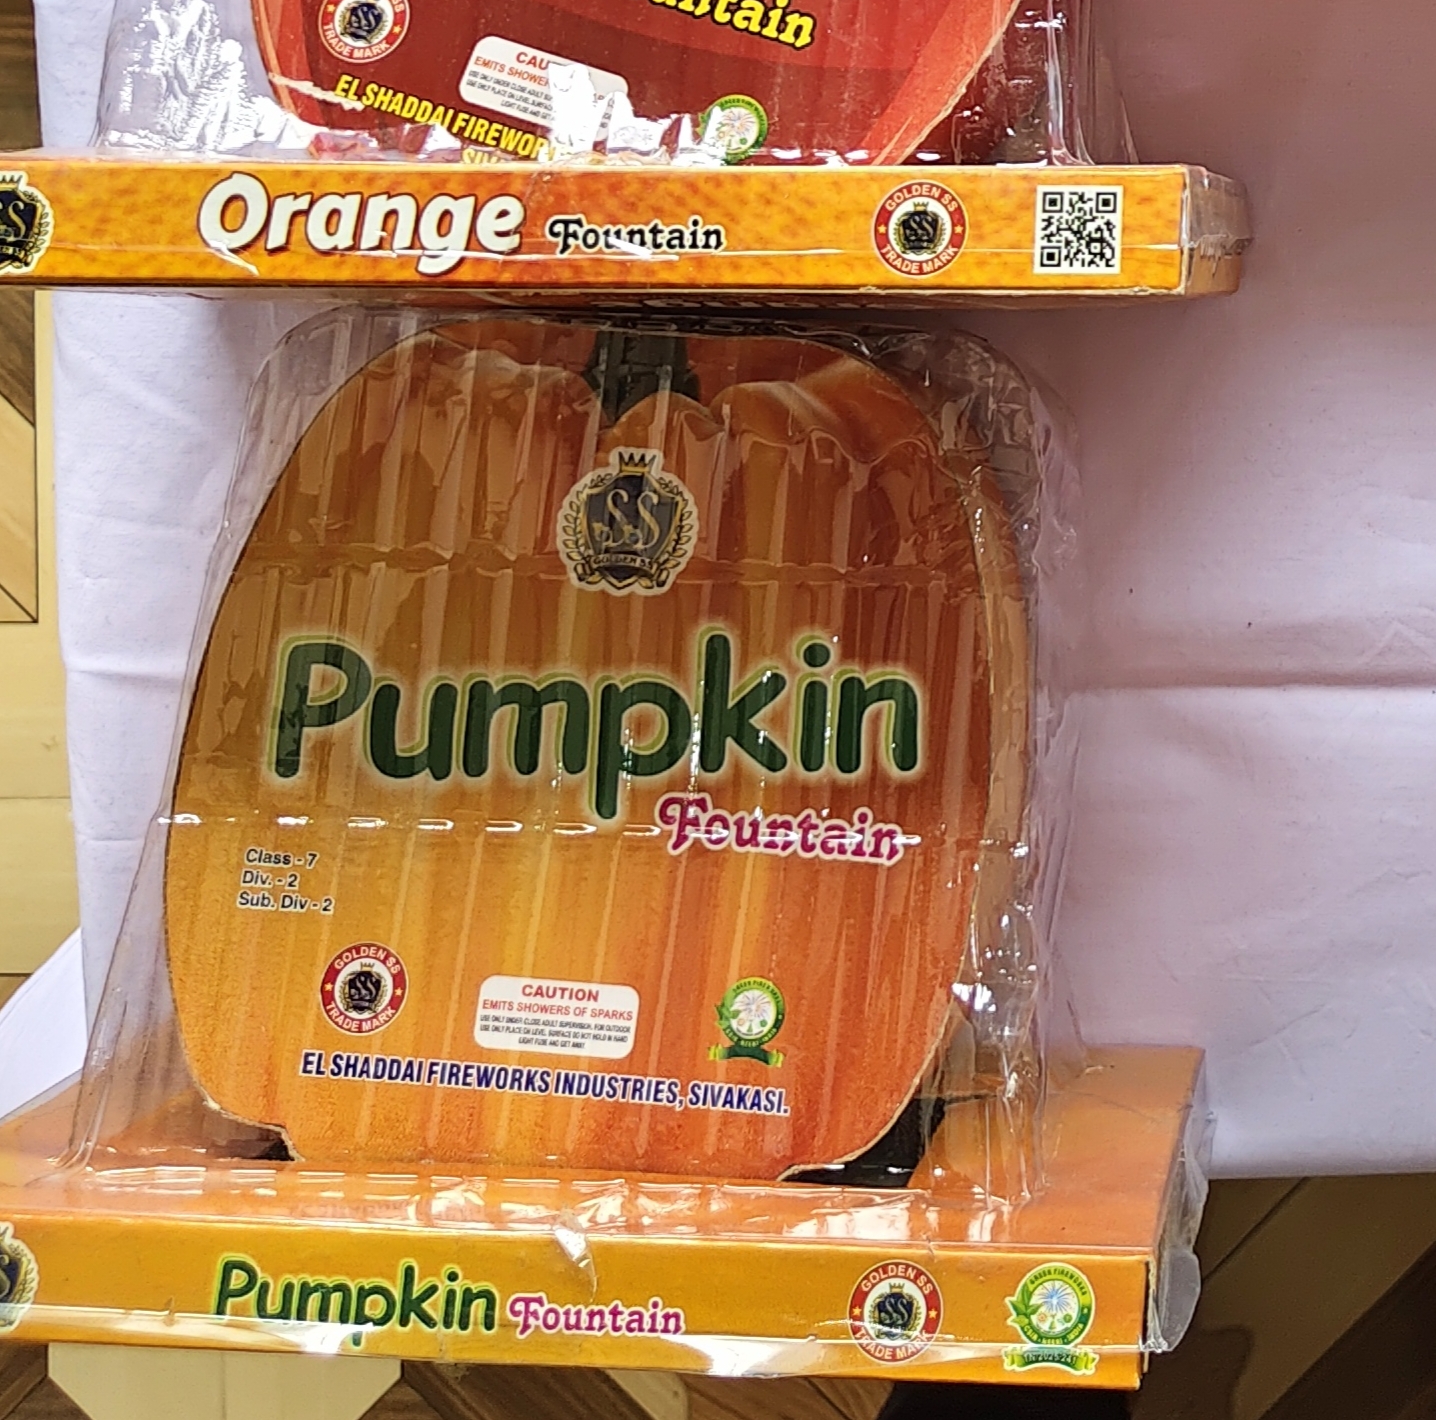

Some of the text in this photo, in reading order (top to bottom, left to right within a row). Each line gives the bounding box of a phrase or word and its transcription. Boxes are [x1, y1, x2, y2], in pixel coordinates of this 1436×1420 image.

[323, 23, 390, 58] TRADE MARK
[335, 75, 359, 101] EL
[362, 83, 454, 127] SHADDAI
[884, 184, 941, 211] GOLDEN
[199, 173, 724, 276] Orange Fountain
[880, 243, 958, 274] TRADE MARK
[271, 624, 920, 820] Pumpkin
[659, 793, 904, 864] Fountain
[246, 849, 291, 865] Class
[242, 870, 271, 885] Div.
[238, 892, 274, 908] Sub.
[281, 895, 308, 909] Div
[333, 946, 387, 970] GOLDEN
[521, 984, 599, 1003] CAUTION
[326, 1001, 395, 1031] TRADE MARK
[482, 999, 633, 1021] EMITS SHOWERS OF SPARKS
[301, 1052, 789, 1115] EL SHADDAI FIREWORKS INDUSTRIES, SIVAKASI.
[861, 1265, 917, 1292] GOLDEN
[214, 1254, 684, 1347] Pumpkin Fountain
[855, 1327, 930, 1359] TRADE MARK
